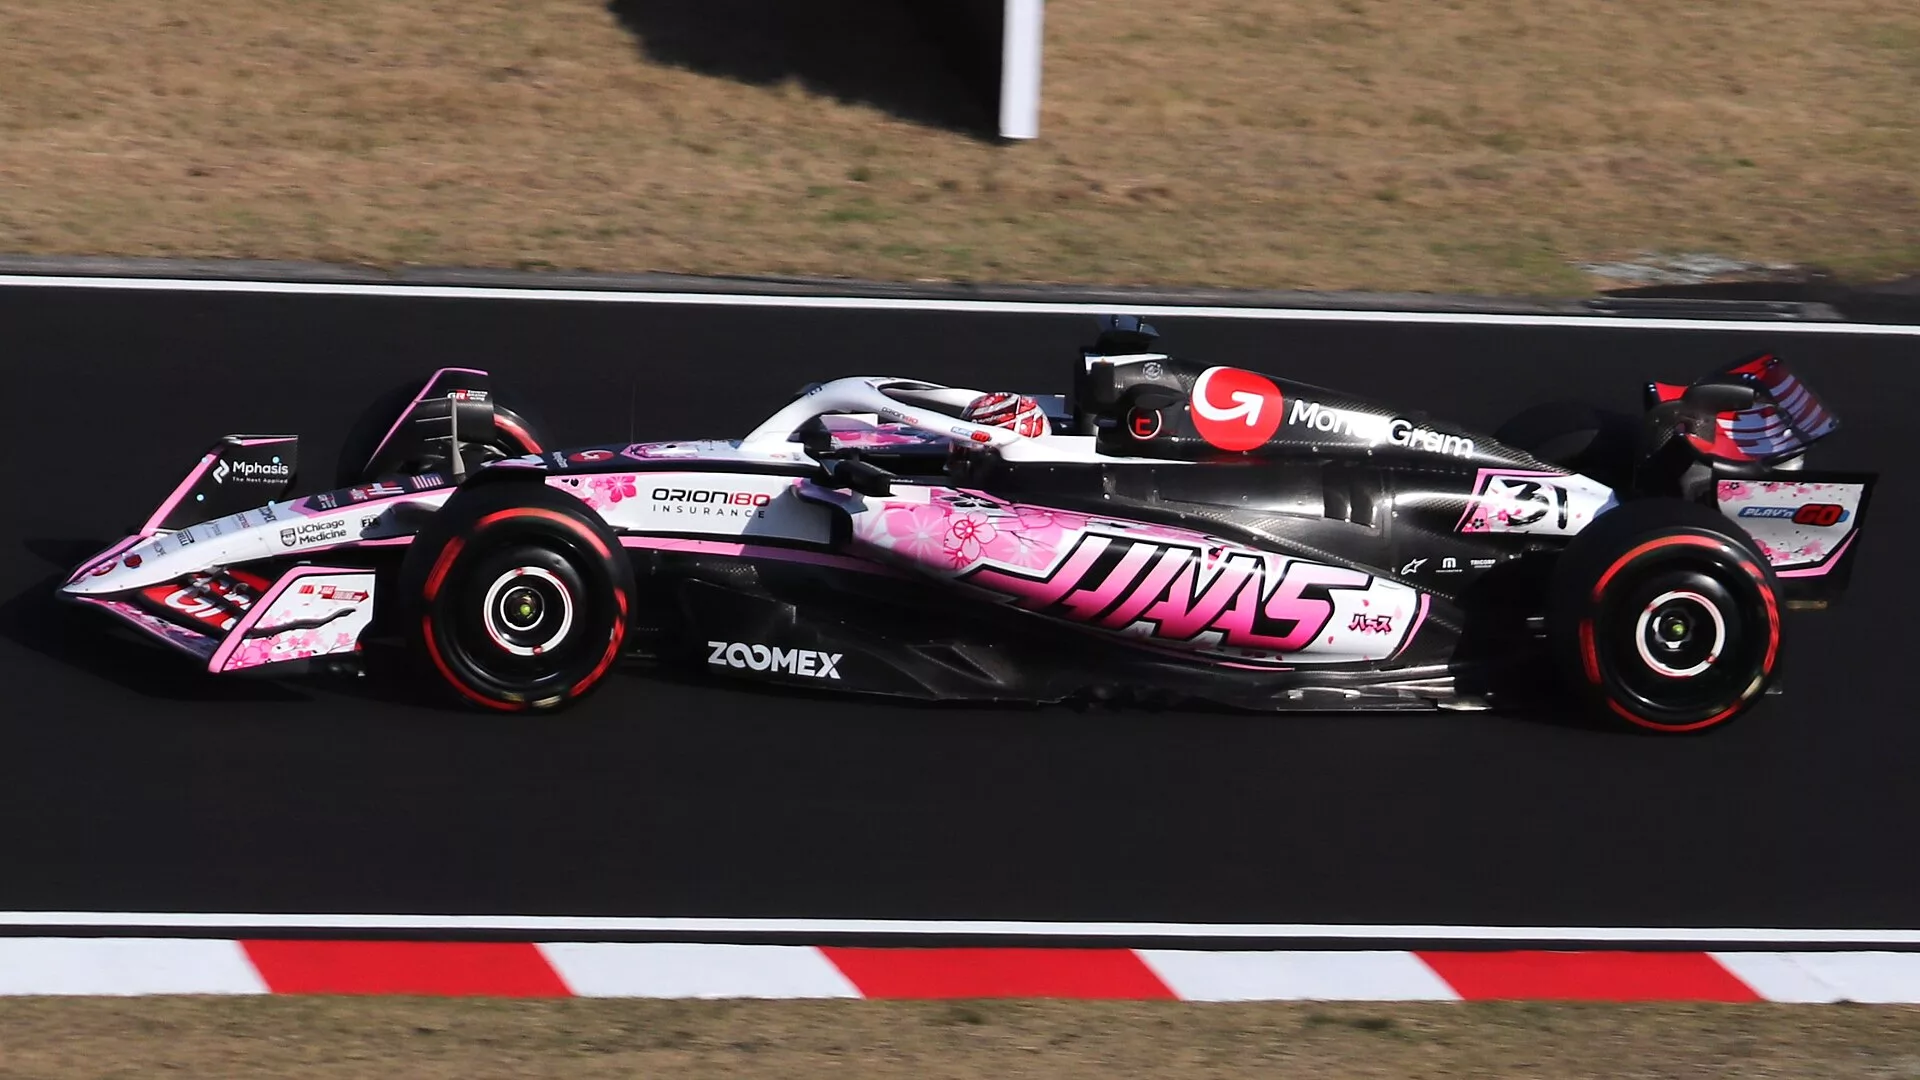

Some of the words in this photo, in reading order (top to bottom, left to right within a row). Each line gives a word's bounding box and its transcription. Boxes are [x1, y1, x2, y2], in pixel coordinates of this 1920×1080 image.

[232, 461, 289, 476] Mphasis
[651, 487, 771, 507] ORION180
[1499, 479, 1569, 531] 31
[652, 504, 765, 519] INSURANCE
[1798, 505, 1837, 525] GO
[296, 518, 345, 535] UChicago
[299, 527, 347, 545] Medicine
[1025, 530, 1374, 653] HAAS
[708, 640, 843, 679] ZOOMEX
